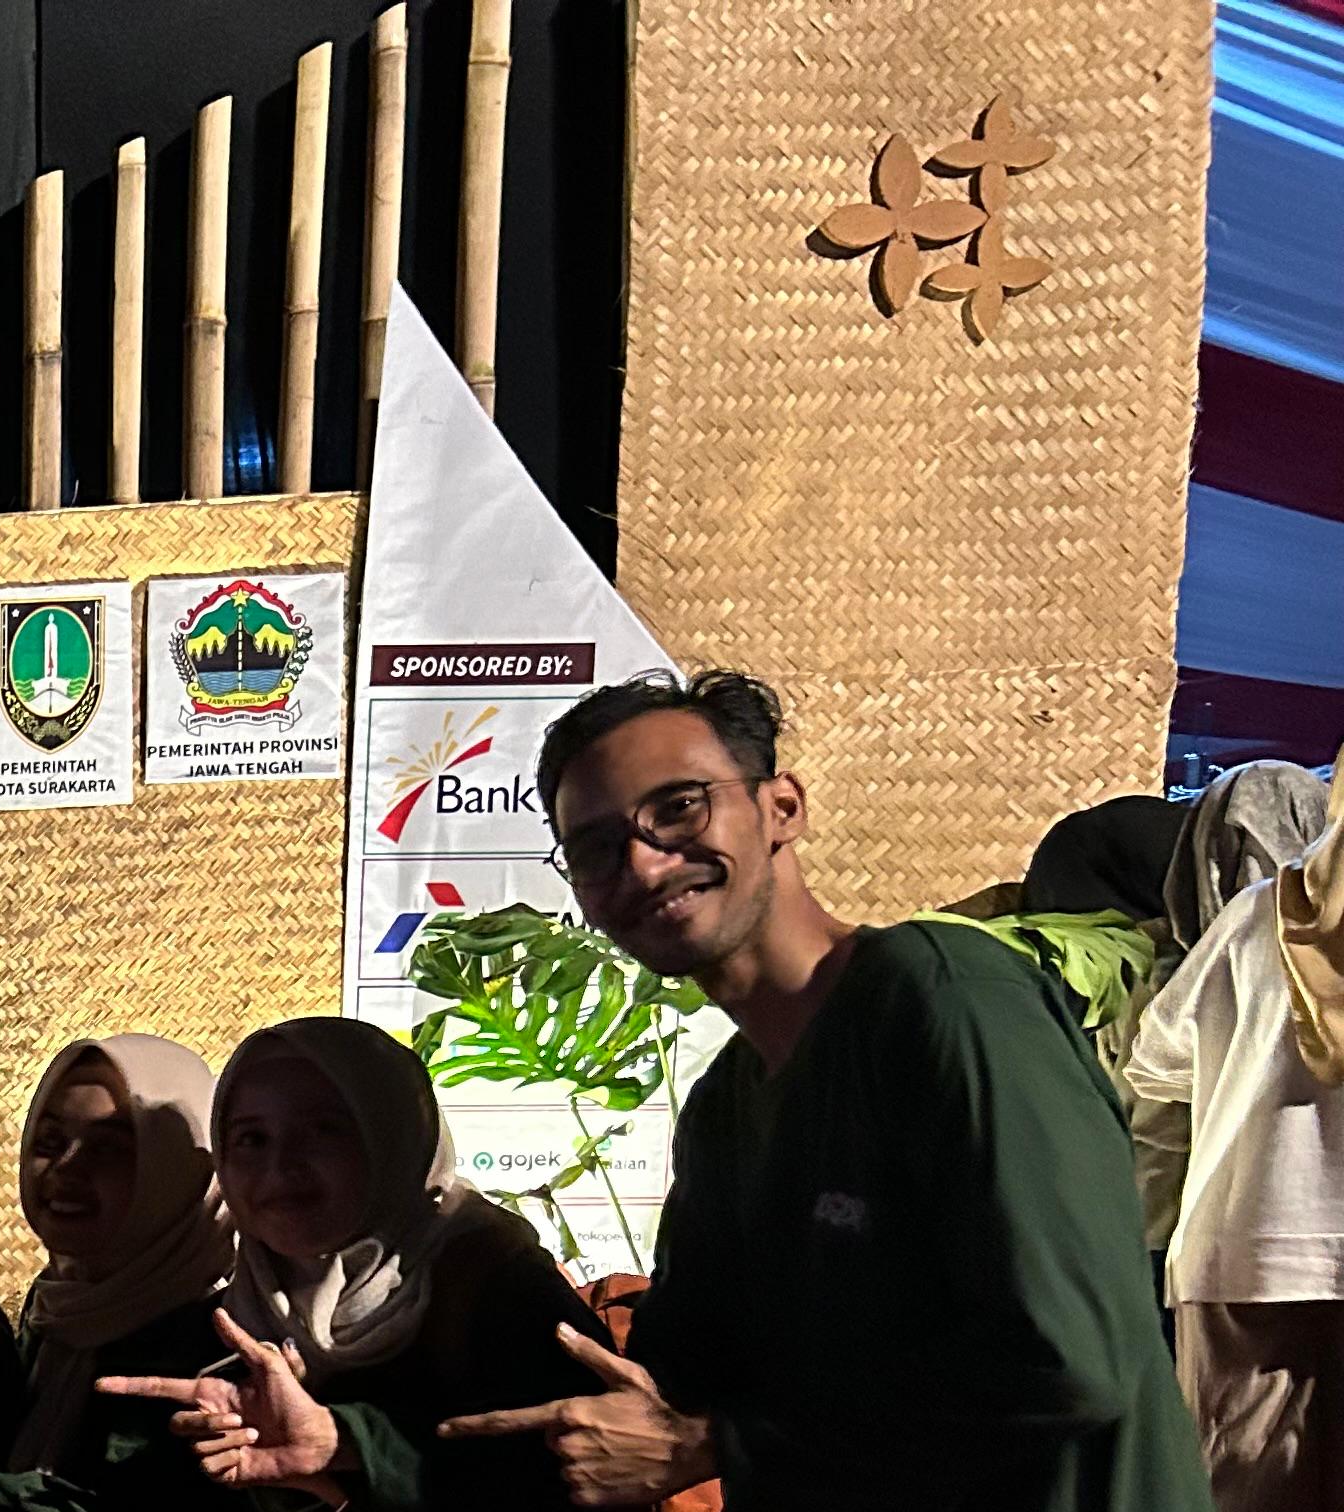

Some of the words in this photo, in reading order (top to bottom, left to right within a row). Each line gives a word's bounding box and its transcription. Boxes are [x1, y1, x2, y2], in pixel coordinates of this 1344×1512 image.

[390, 656, 532, 678] SPONSORED
[536, 655, 573, 676] BY:
[147, 740, 255, 759] PEMERINTAH
[259, 737, 338, 754] PROVINSI
[0, 758, 97, 776] PEMERINTAH
[189, 762, 232, 778] JAWA
[236, 759, 303, 776] TENGAH
[28, 778, 116, 795] SURAKARTA
[436, 774, 538, 814] Bank
[499, 1150, 561, 1171] gojek
